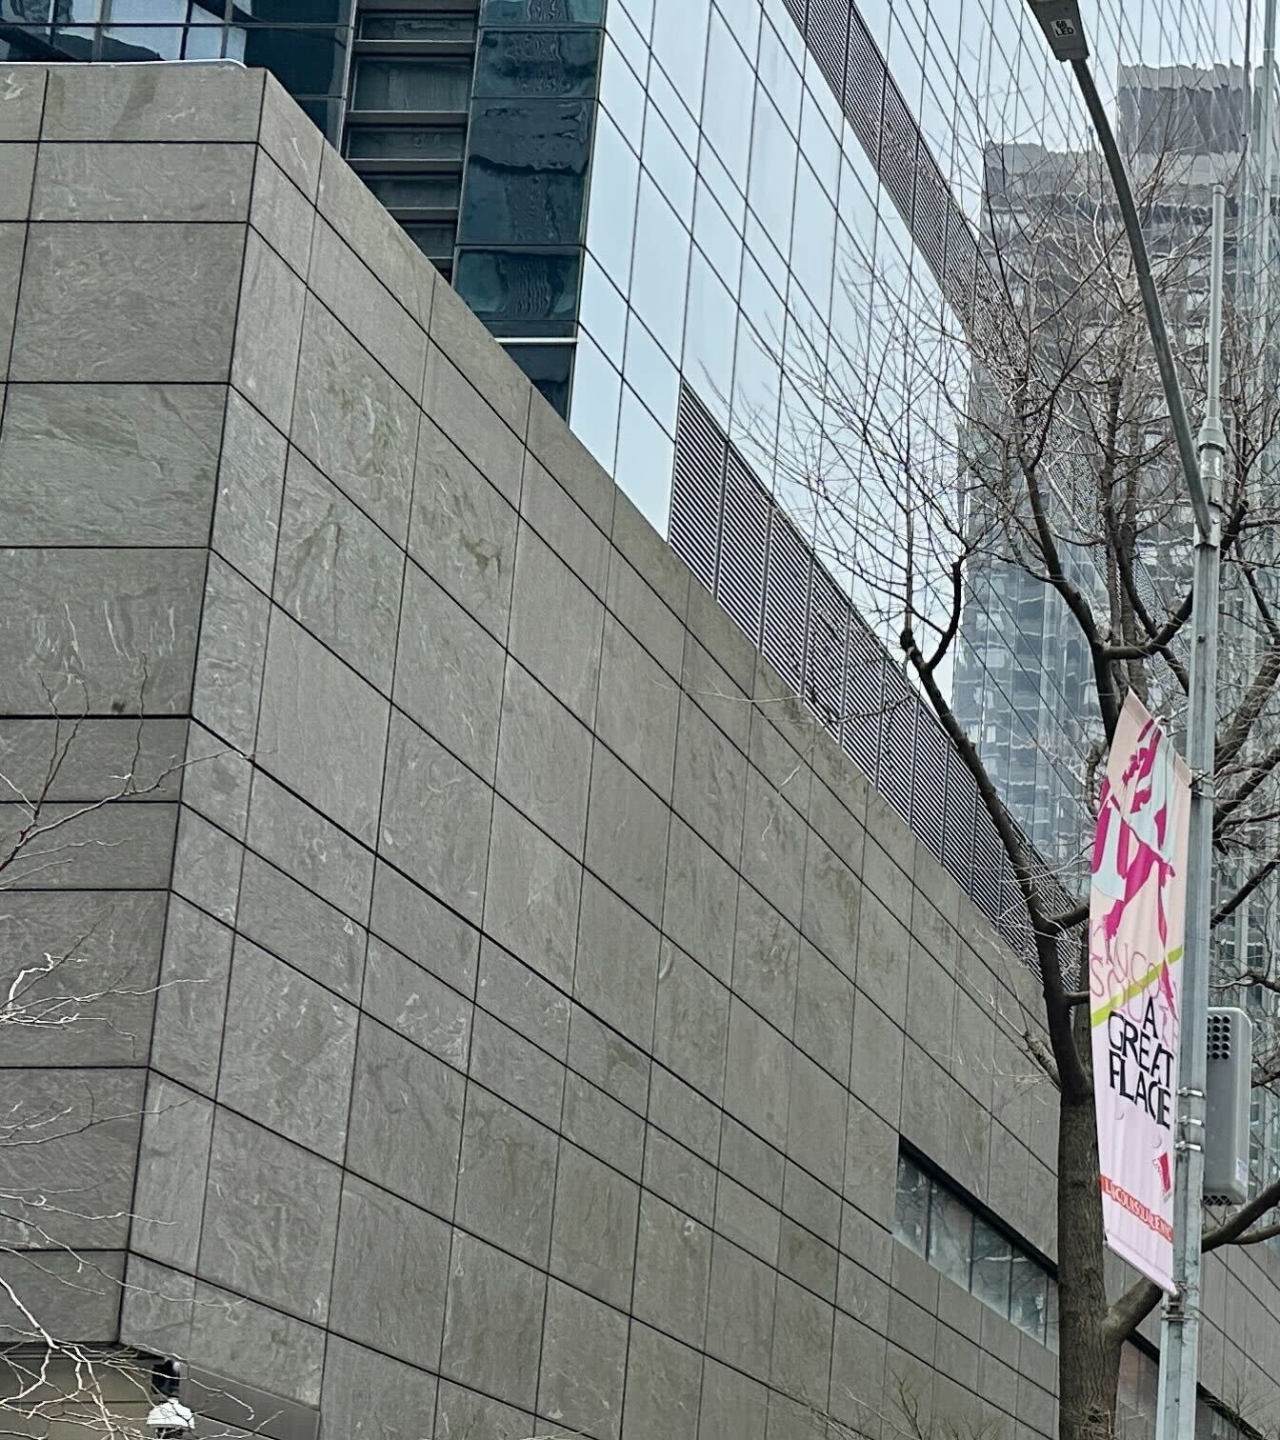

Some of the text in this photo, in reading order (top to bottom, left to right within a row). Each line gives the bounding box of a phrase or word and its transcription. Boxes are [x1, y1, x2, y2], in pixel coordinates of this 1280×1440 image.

[1108, 1010, 1174, 1088] GREAT
[1143, 996, 1159, 1040] A
[1109, 1048, 1171, 1130] PLACE
